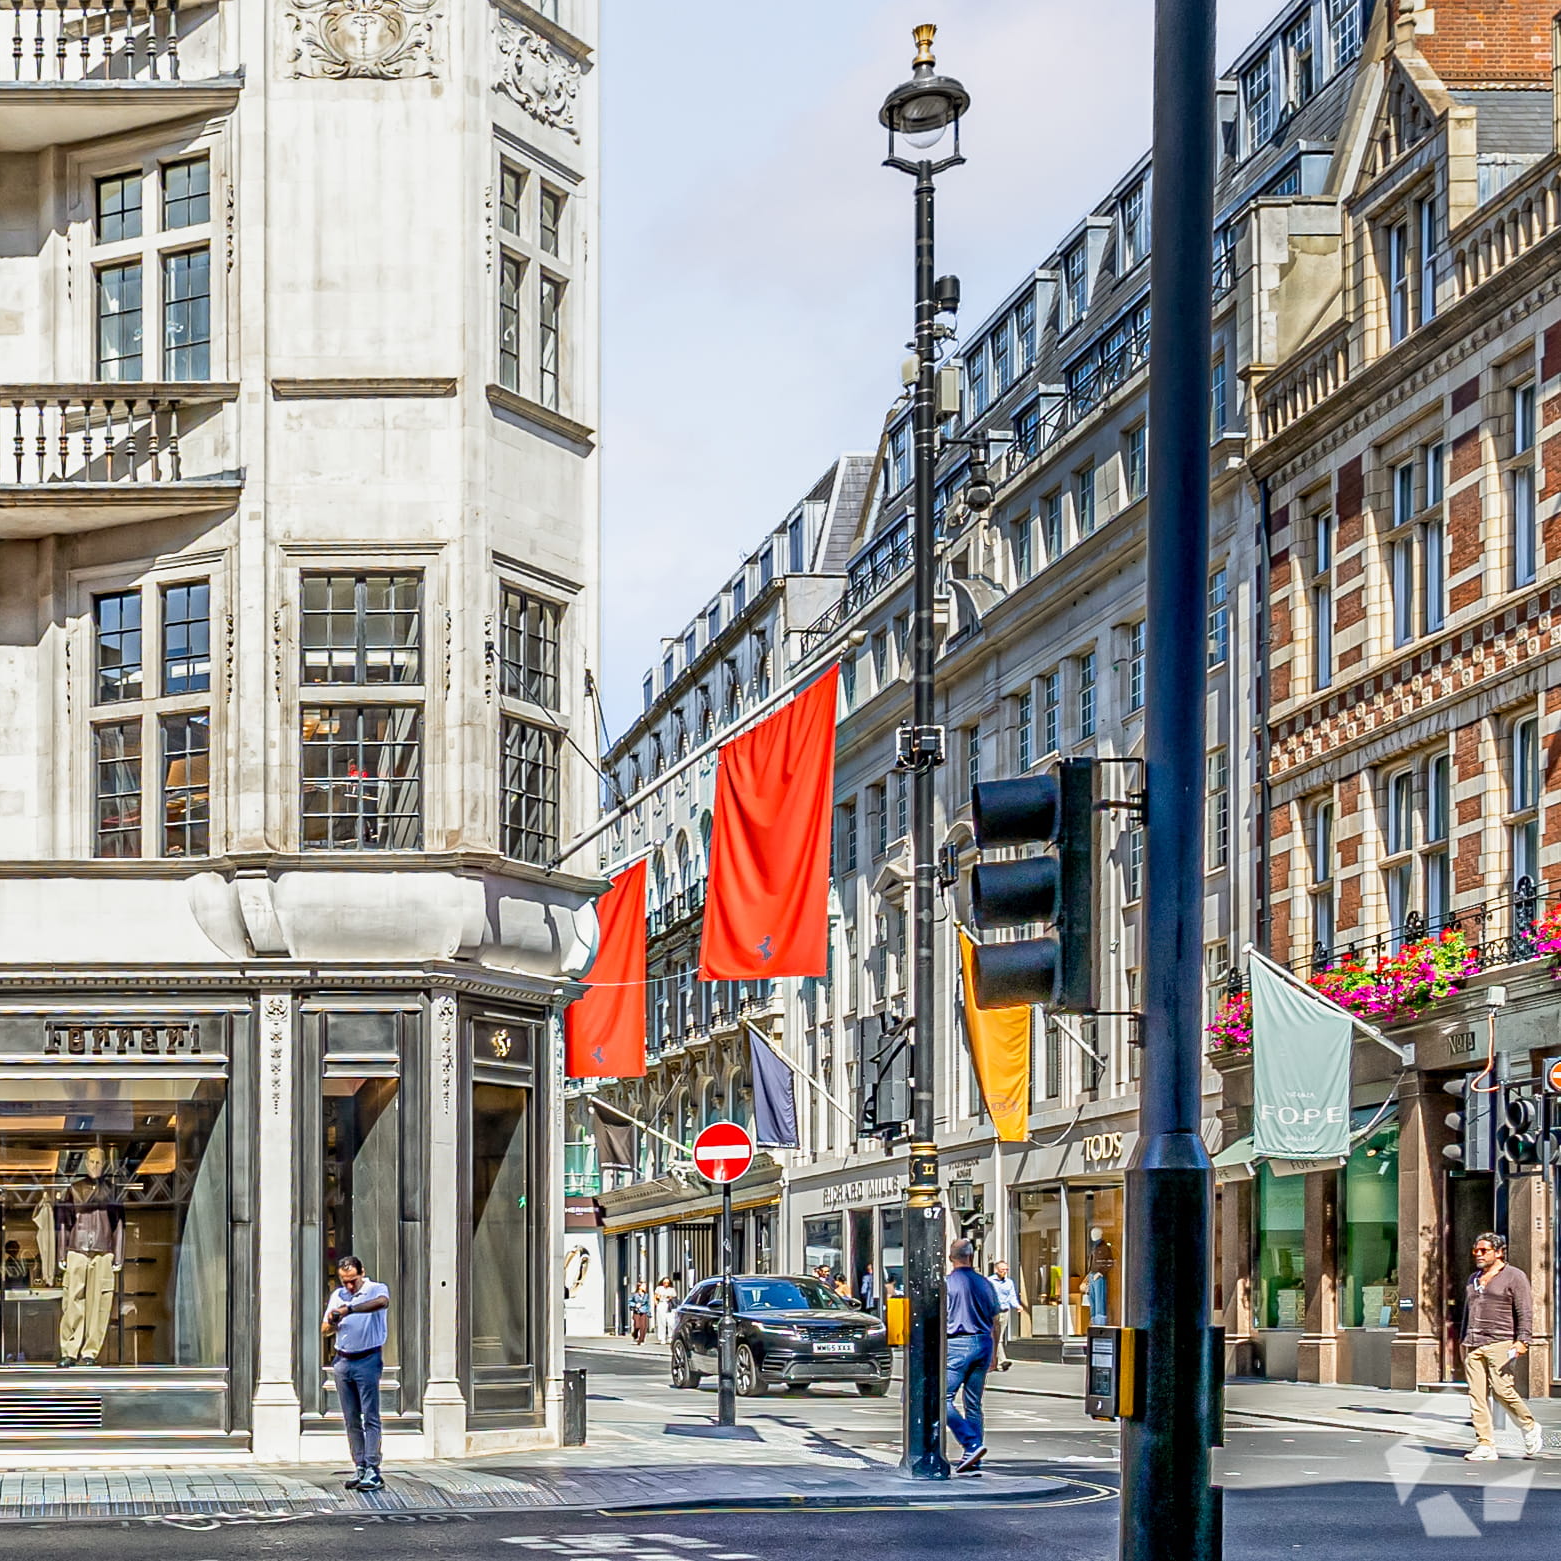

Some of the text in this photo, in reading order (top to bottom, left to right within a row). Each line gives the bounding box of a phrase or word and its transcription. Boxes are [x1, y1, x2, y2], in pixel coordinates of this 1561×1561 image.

[1260, 1104, 1344, 1125] FOPE
[1290, 1160, 1319, 1171] FOPE
[923, 1207, 941, 1219] 67
